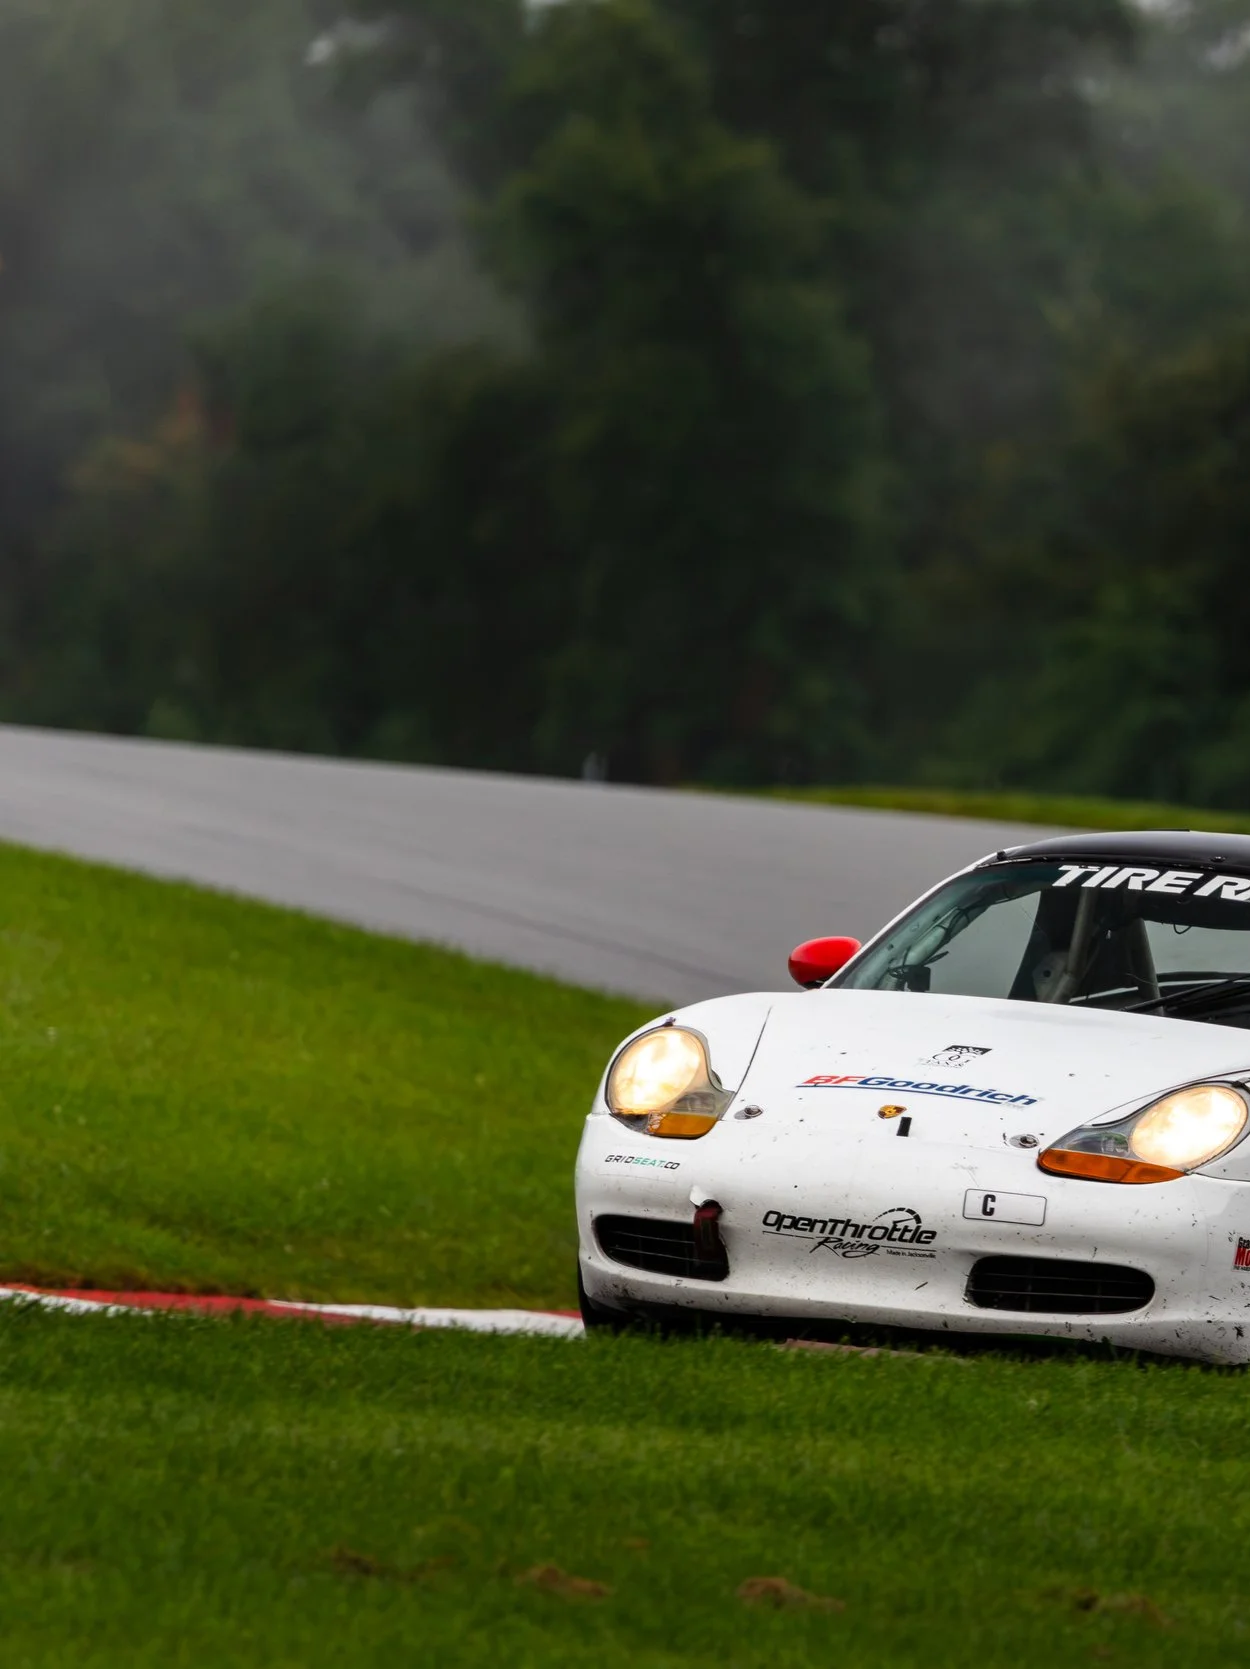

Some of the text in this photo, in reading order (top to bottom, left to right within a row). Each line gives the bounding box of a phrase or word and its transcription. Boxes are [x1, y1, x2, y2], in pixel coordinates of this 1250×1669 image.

[1051, 864, 1204, 894] TIRE
[802, 1075, 1039, 1106] BFGoodrich
[604, 1154, 681, 1170] GRIDSEAT.CO
[981, 1193, 996, 1217] C
[762, 1210, 938, 1245] OpenThrottle
[809, 1236, 881, 1259] Racing
